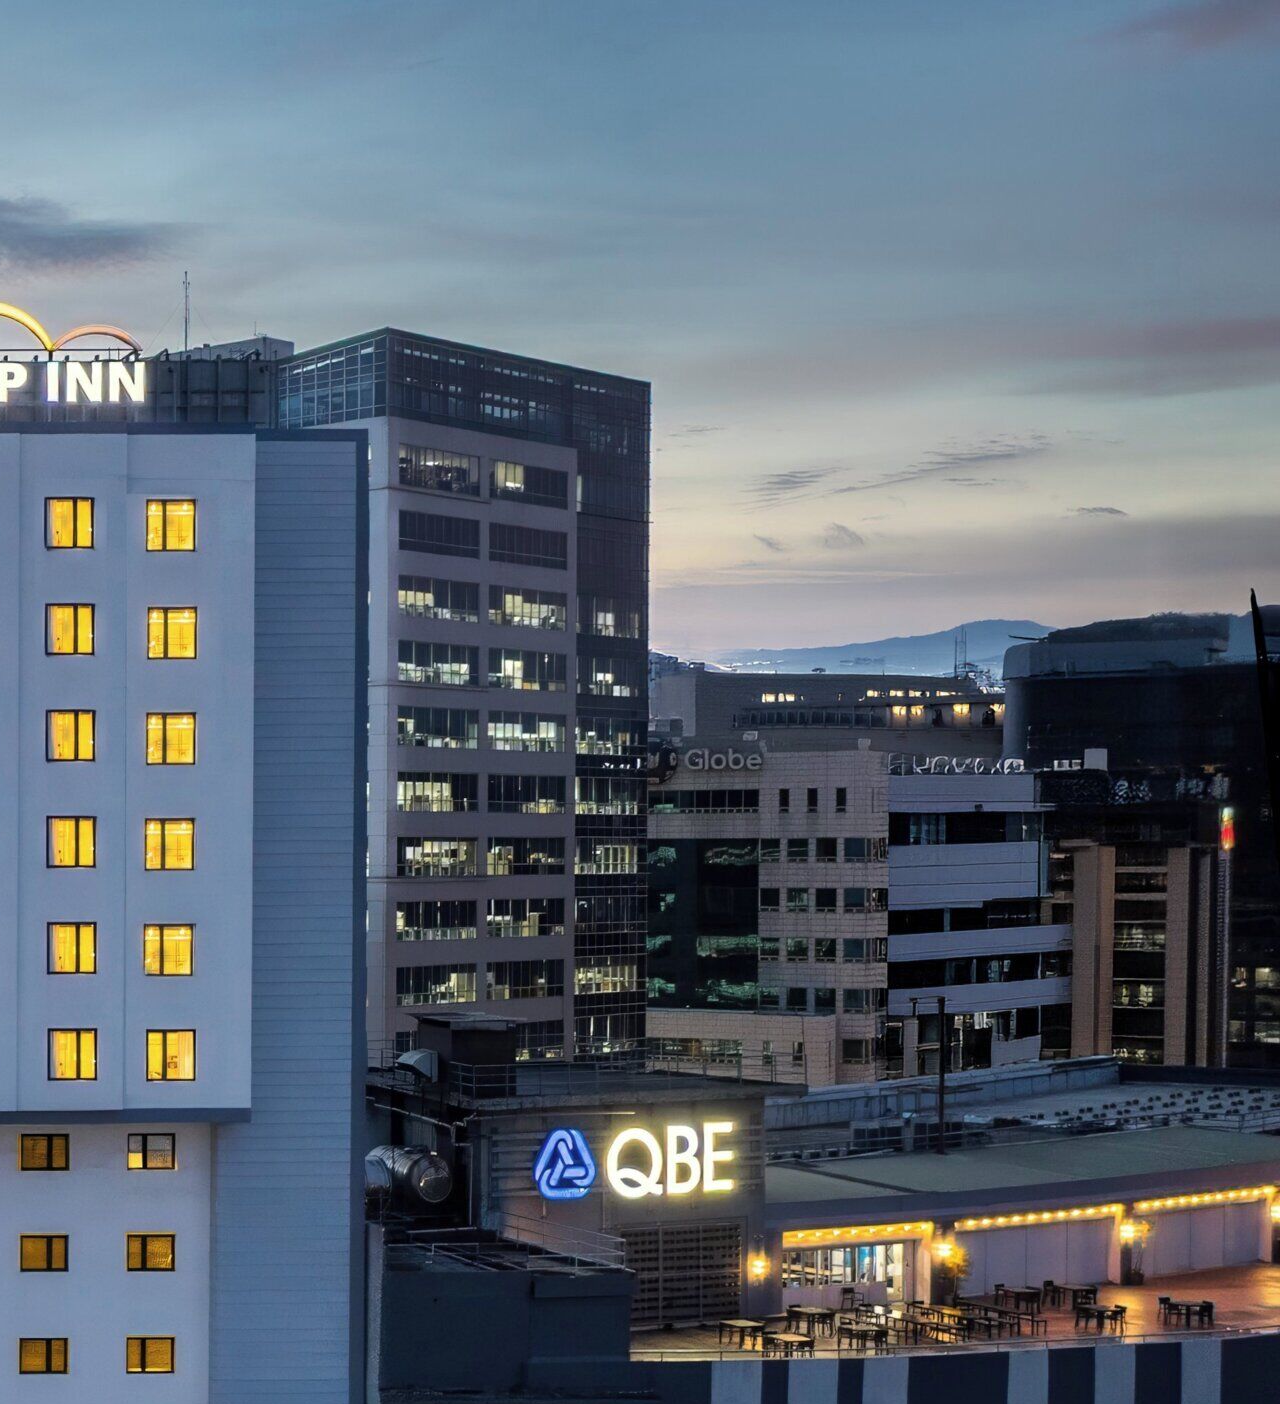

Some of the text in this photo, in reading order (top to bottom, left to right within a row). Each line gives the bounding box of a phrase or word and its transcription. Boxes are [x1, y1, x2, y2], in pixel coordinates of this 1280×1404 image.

[47, 362, 145, 402] INN
[685, 748, 762, 770] Globe
[606, 1121, 734, 1198] QBE
